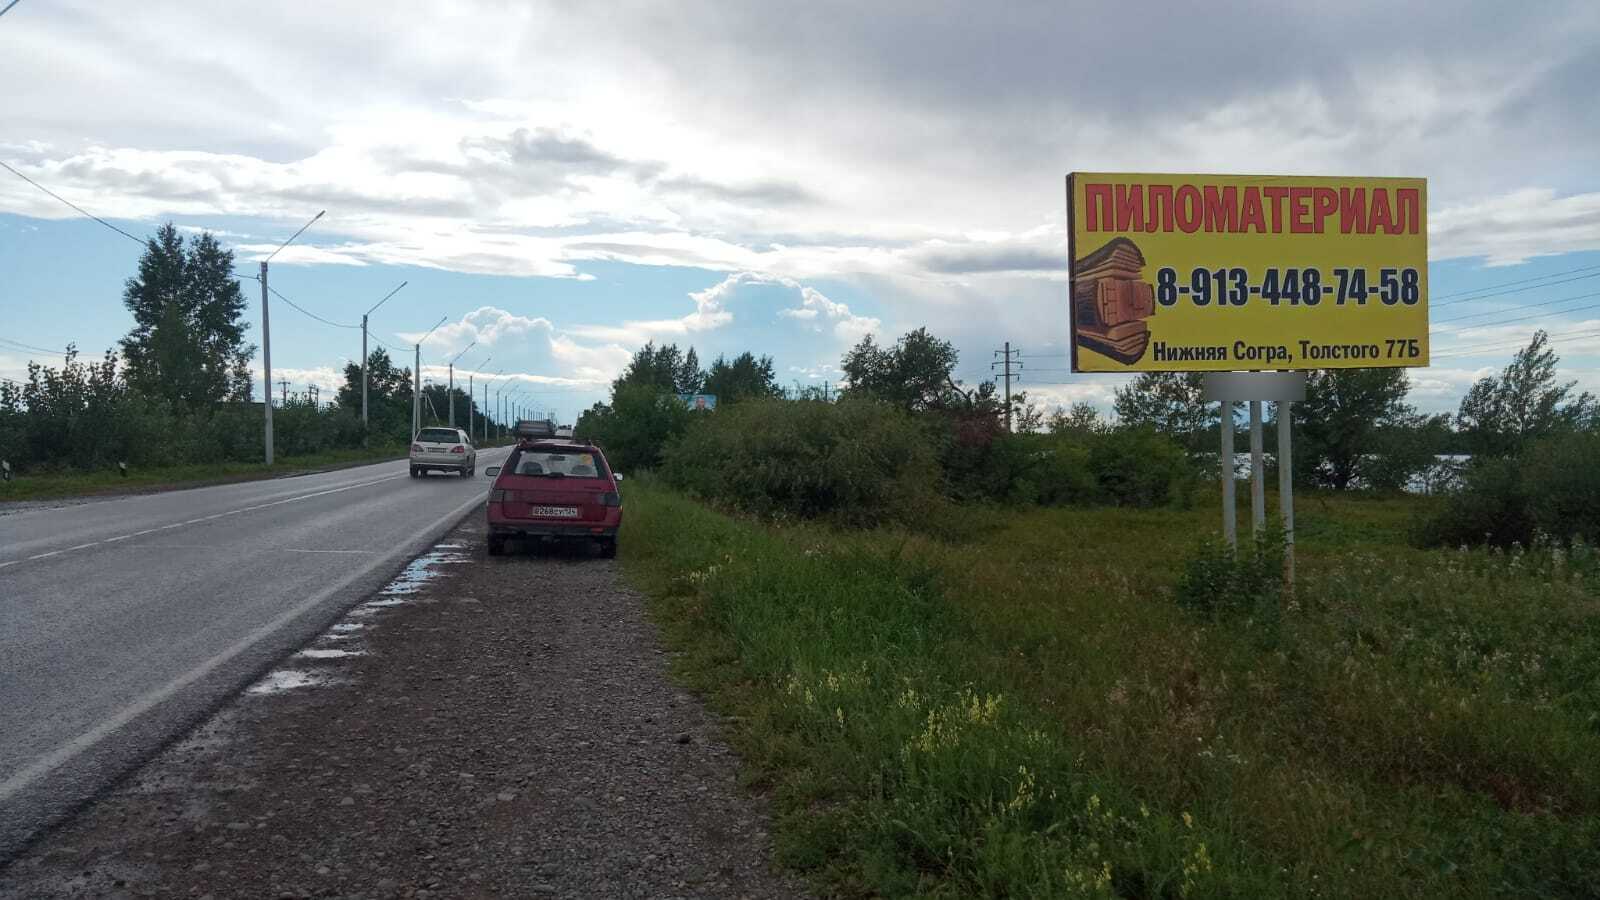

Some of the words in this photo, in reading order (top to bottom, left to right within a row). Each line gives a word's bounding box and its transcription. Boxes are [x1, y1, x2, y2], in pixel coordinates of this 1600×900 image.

[1085, 183, 1420, 235] ПИЛОМАТЕРИАЛ
[1157, 266, 1419, 307] 8-913-448-74-58
[1153, 341, 1228, 362] Нижняя
[1233, 340, 1293, 364] Согра,
[1299, 340, 1380, 360] Толстого
[1385, 339, 1420, 358] 77Б
